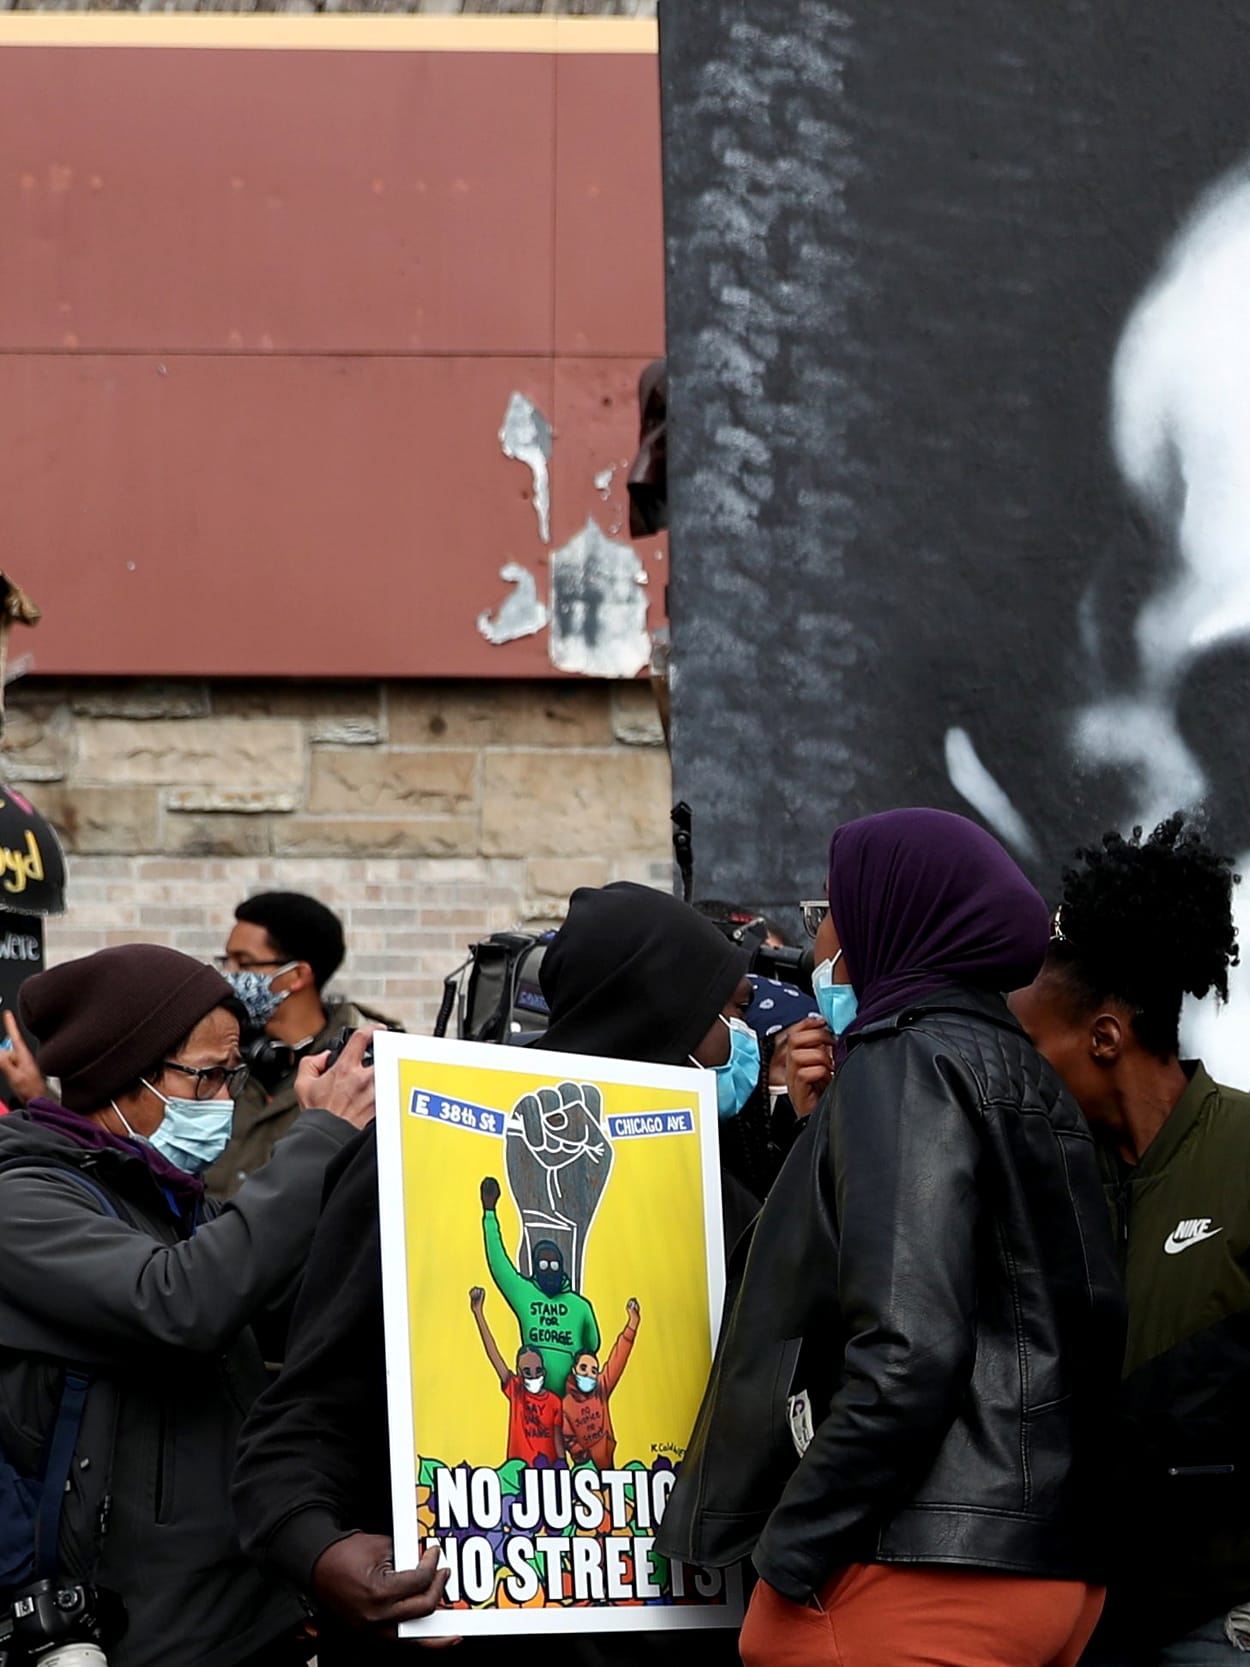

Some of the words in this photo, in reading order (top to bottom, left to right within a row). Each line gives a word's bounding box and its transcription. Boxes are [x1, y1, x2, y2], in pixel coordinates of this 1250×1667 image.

[415, 1093, 431, 1116] E
[439, 1101, 477, 1128] 38th
[479, 1112, 497, 1133] St
[614, 1116, 663, 1136] CHICAGO
[667, 1115, 687, 1131] AVE
[1173, 1218, 1212, 1239] NIKE
[530, 1302, 569, 1316] STAND
[539, 1316, 560, 1327] FOR
[529, 1327, 574, 1346] GEORGE
[436, 1467, 502, 1529] NO
[512, 1467, 677, 1530] JUSTIC
[425, 1536, 495, 1602] NO
